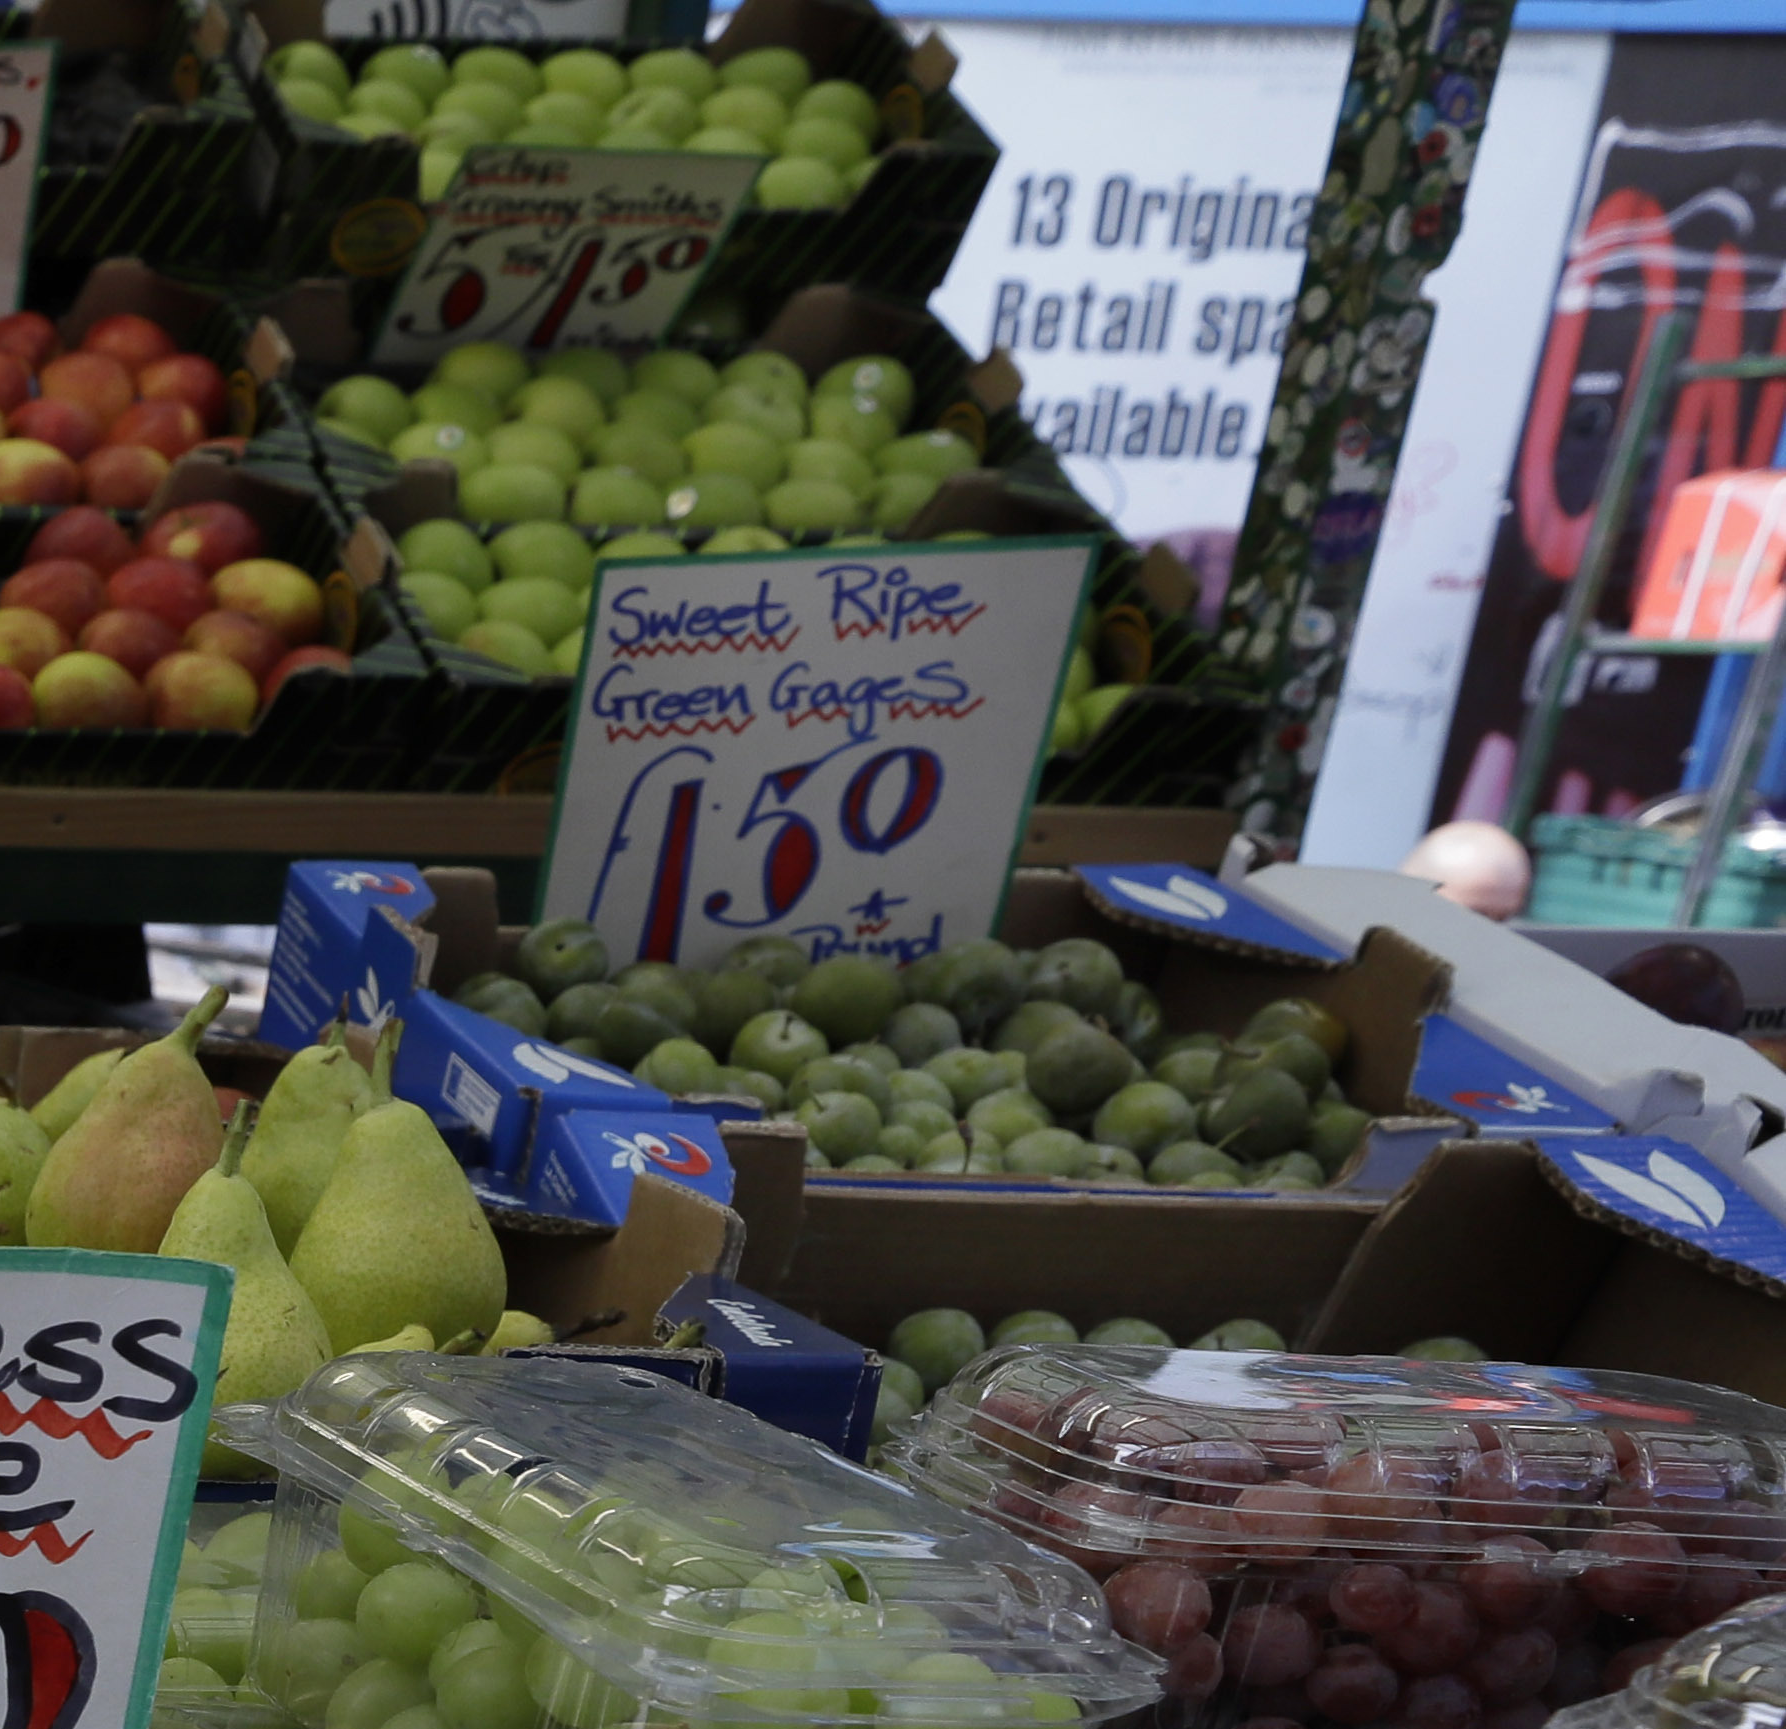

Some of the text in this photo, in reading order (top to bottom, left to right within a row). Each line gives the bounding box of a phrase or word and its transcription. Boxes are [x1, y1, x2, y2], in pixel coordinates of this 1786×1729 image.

[1012, 175, 1071, 247] 13
[994, 279, 1176, 353] Retail
[609, 564, 975, 647] Sweet Ripe
[591, 660, 971, 741] Green Gages
